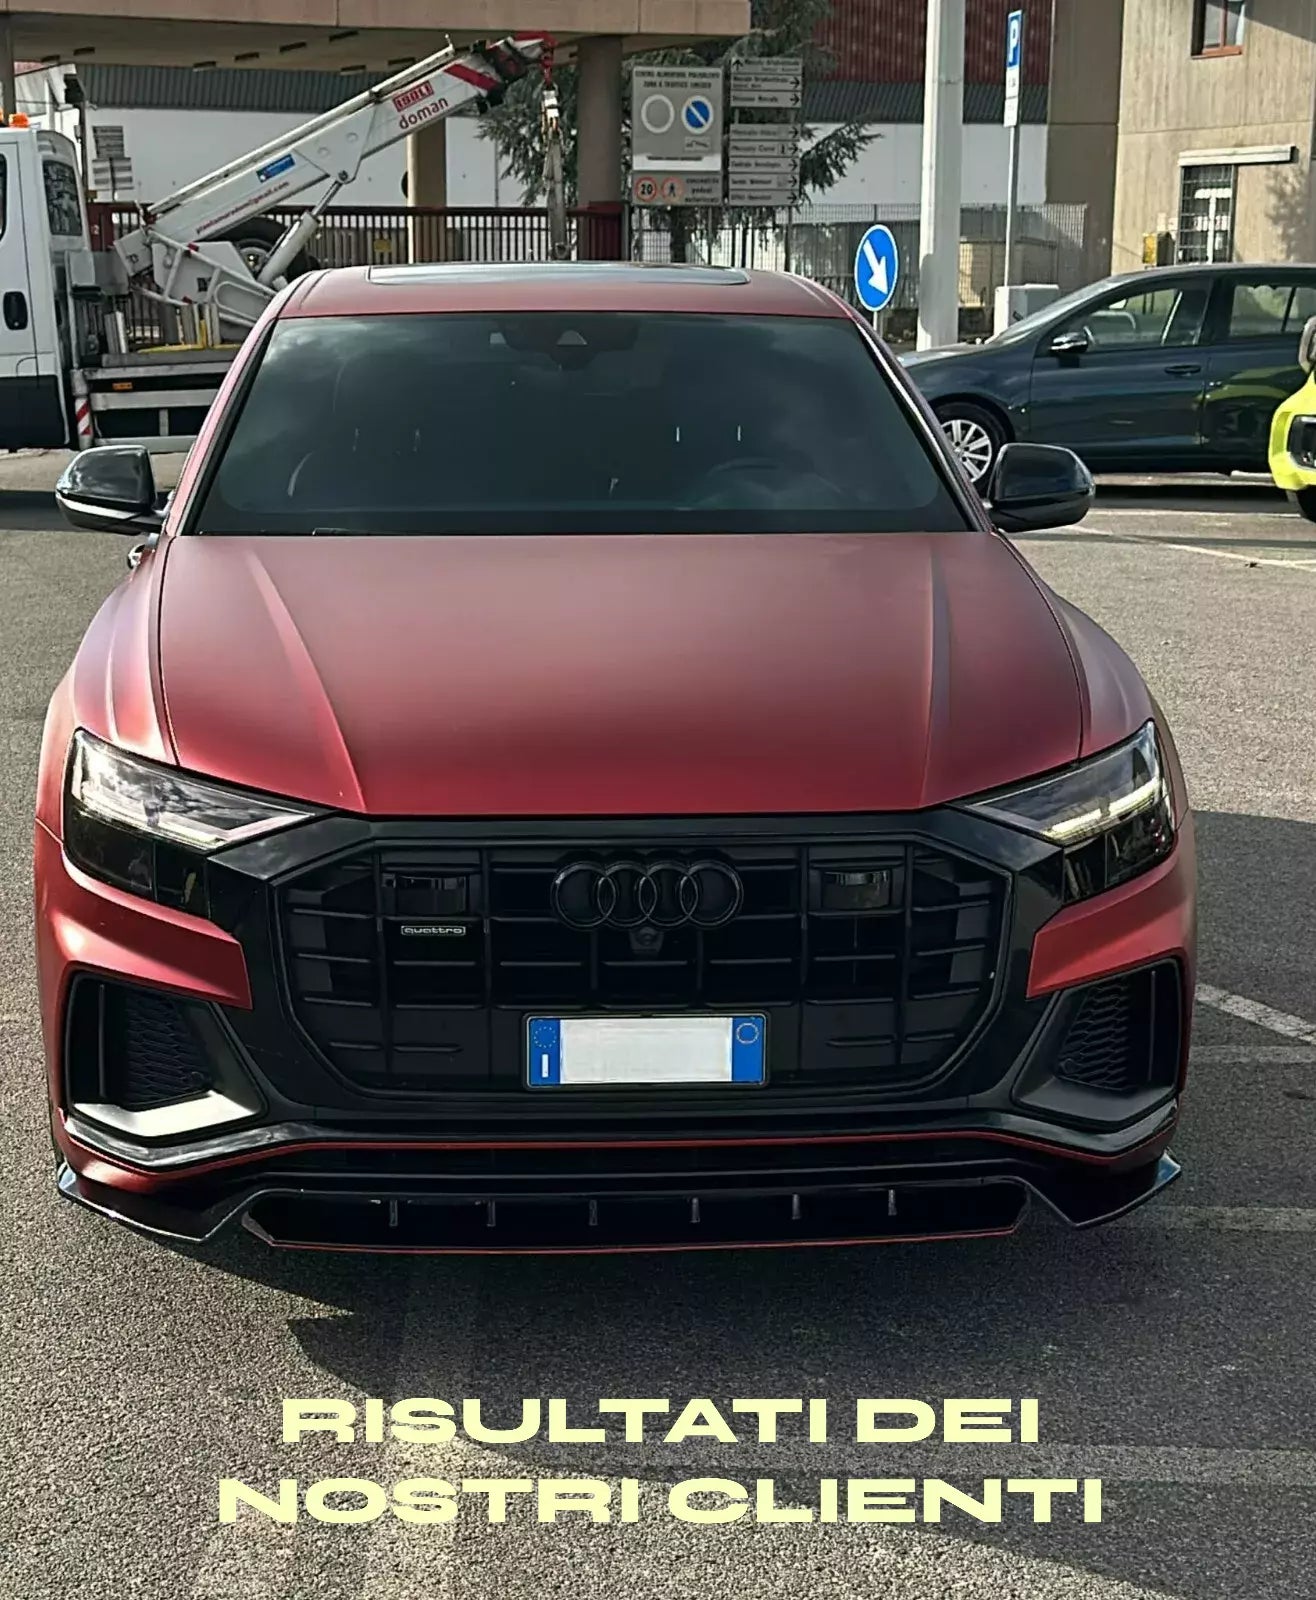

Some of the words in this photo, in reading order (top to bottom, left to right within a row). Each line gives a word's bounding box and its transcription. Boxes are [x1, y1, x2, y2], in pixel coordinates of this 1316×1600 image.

[1008, 19, 1019, 63] P
[399, 97, 449, 129] doman
[641, 183, 653, 195] 20
[404, 927, 463, 936] quattro
